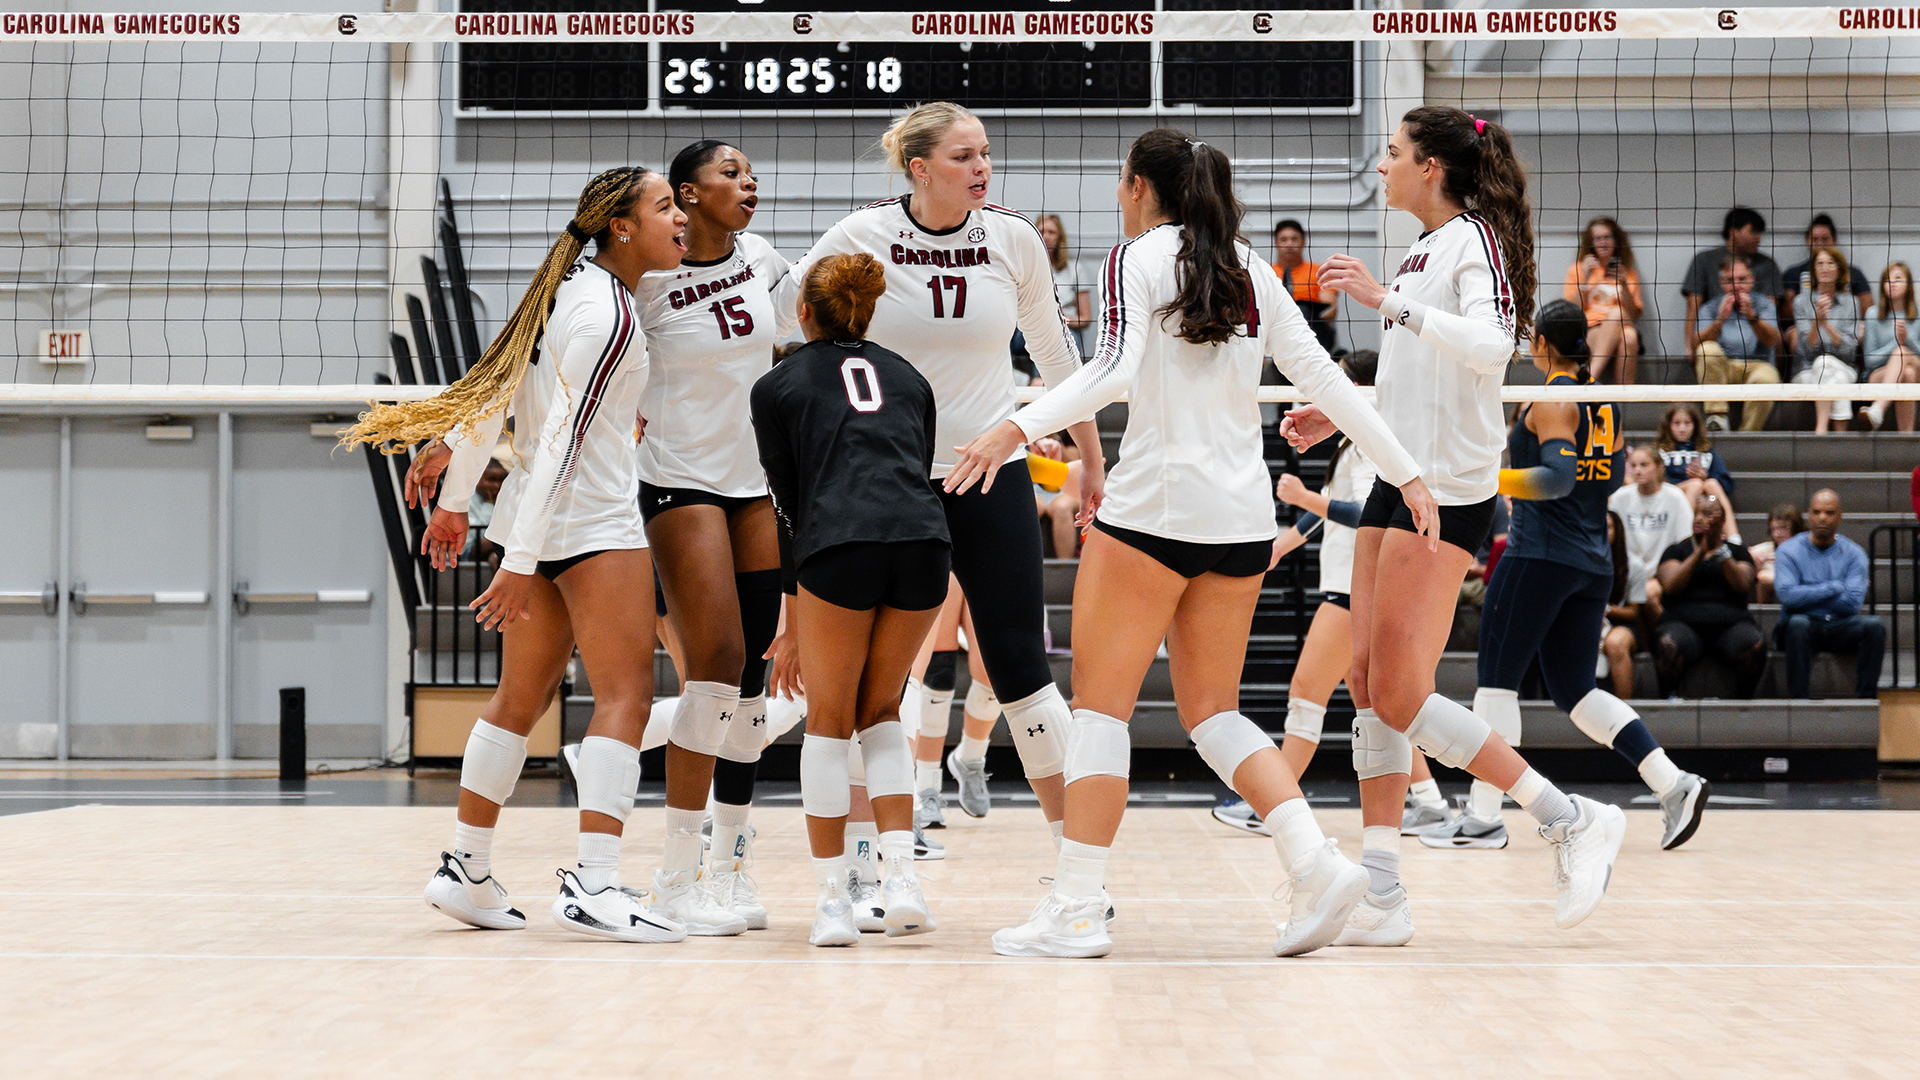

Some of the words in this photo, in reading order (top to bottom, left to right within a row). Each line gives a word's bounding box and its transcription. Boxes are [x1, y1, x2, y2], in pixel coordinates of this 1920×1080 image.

[3, 14, 105, 35] CAROLINA
[114, 14, 240, 35] GAMECOCKS
[455, 14, 558, 36] CAROLINA
[567, 13, 695, 36] GAMECOCKS
[911, 13, 1016, 35] CAROLINA
[1024, 13, 1154, 35] GAMECOCKS
[1372, 12, 1478, 34] CAROLINA
[1487, 11, 1617, 33] GAMECOCKS
[968, 227, 986, 243] SEC
[890, 243, 991, 269] CAROLINA
[668, 264, 756, 310] CAROLINA
[926, 275, 968, 319] 17
[708, 294, 755, 340] 15
[49, 333, 82, 358] EXIT
[838, 355, 885, 414] 0
[1584, 403, 1615, 457] 14
[1576, 458, 1612, 482] ETS
